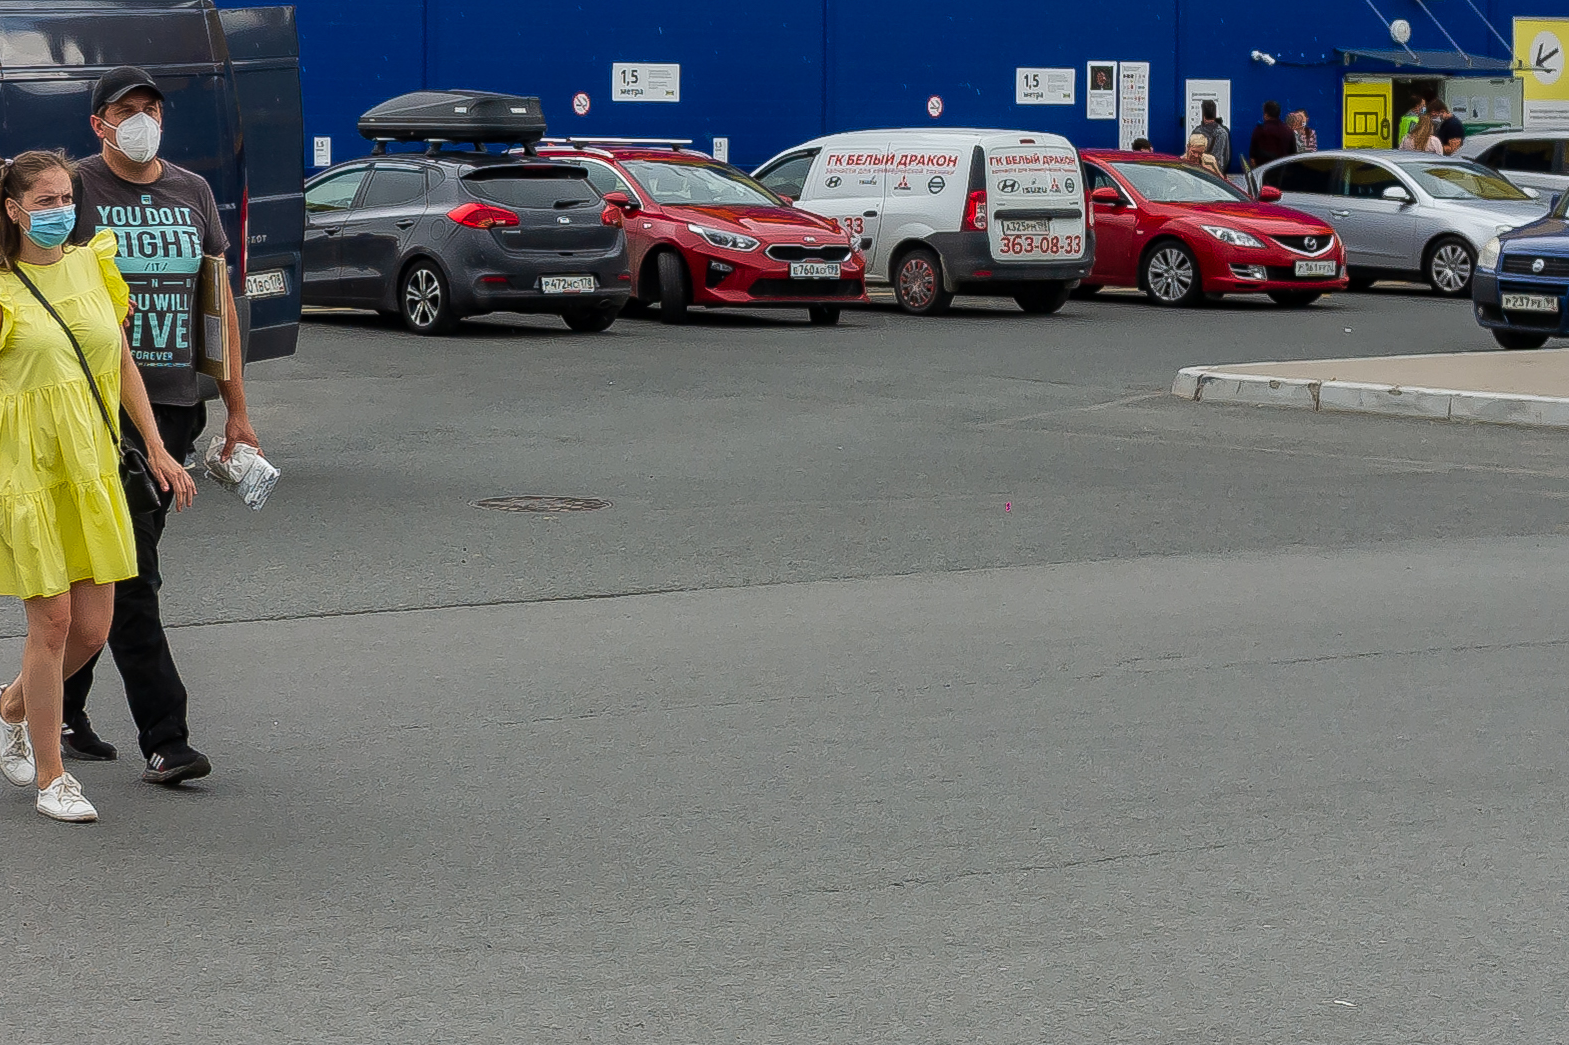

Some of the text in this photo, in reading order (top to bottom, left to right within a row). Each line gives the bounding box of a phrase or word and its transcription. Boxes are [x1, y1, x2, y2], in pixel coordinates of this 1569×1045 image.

[620, 69, 638, 86] 1,5
[1023, 74, 1039, 90] 1,5
[827, 153, 958, 167] ГК БЕЛЫЙ ДРАКОН
[1005, 153, 1040, 165] БЕЛЫЙ
[97, 206, 190, 225] YOU DO IT
[1000, 235, 1081, 254] 363-08-33
[153, 294, 189, 311] WILL
[132, 312, 188, 348] IVE
